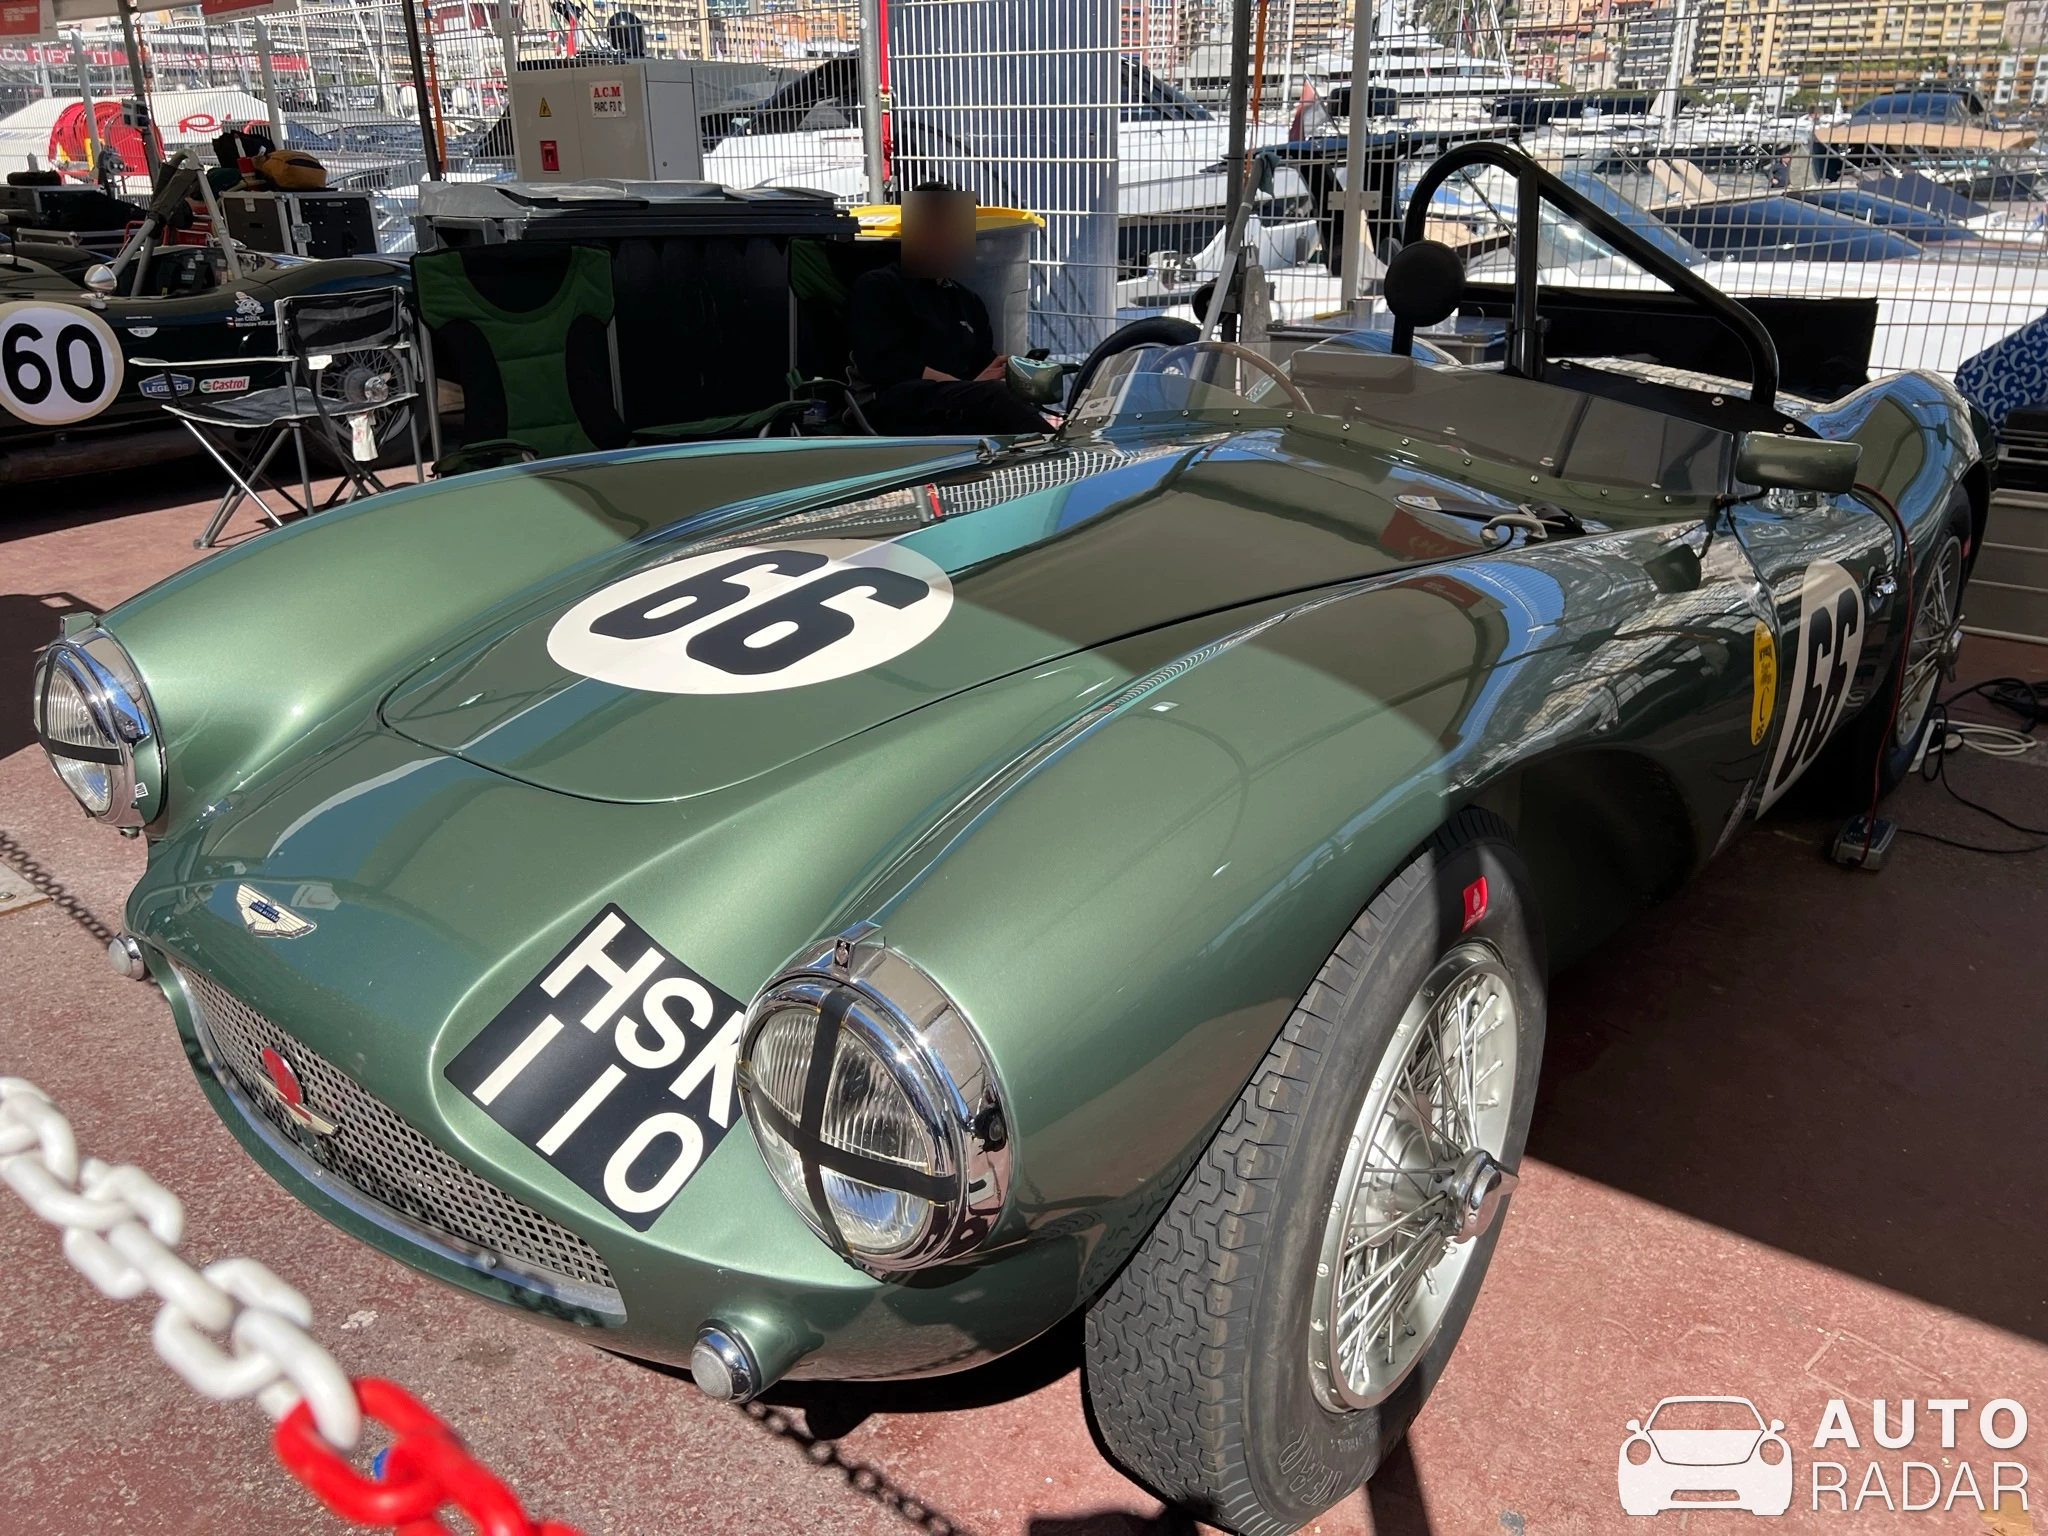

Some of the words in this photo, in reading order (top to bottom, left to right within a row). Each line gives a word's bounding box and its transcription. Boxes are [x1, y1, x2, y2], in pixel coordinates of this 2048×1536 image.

[3, 322, 105, 405] 60
[146, 383, 190, 394] LEGEDS
[212, 378, 246, 391] Castrol
[590, 549, 929, 675] 66
[1774, 588, 1858, 792] 66
